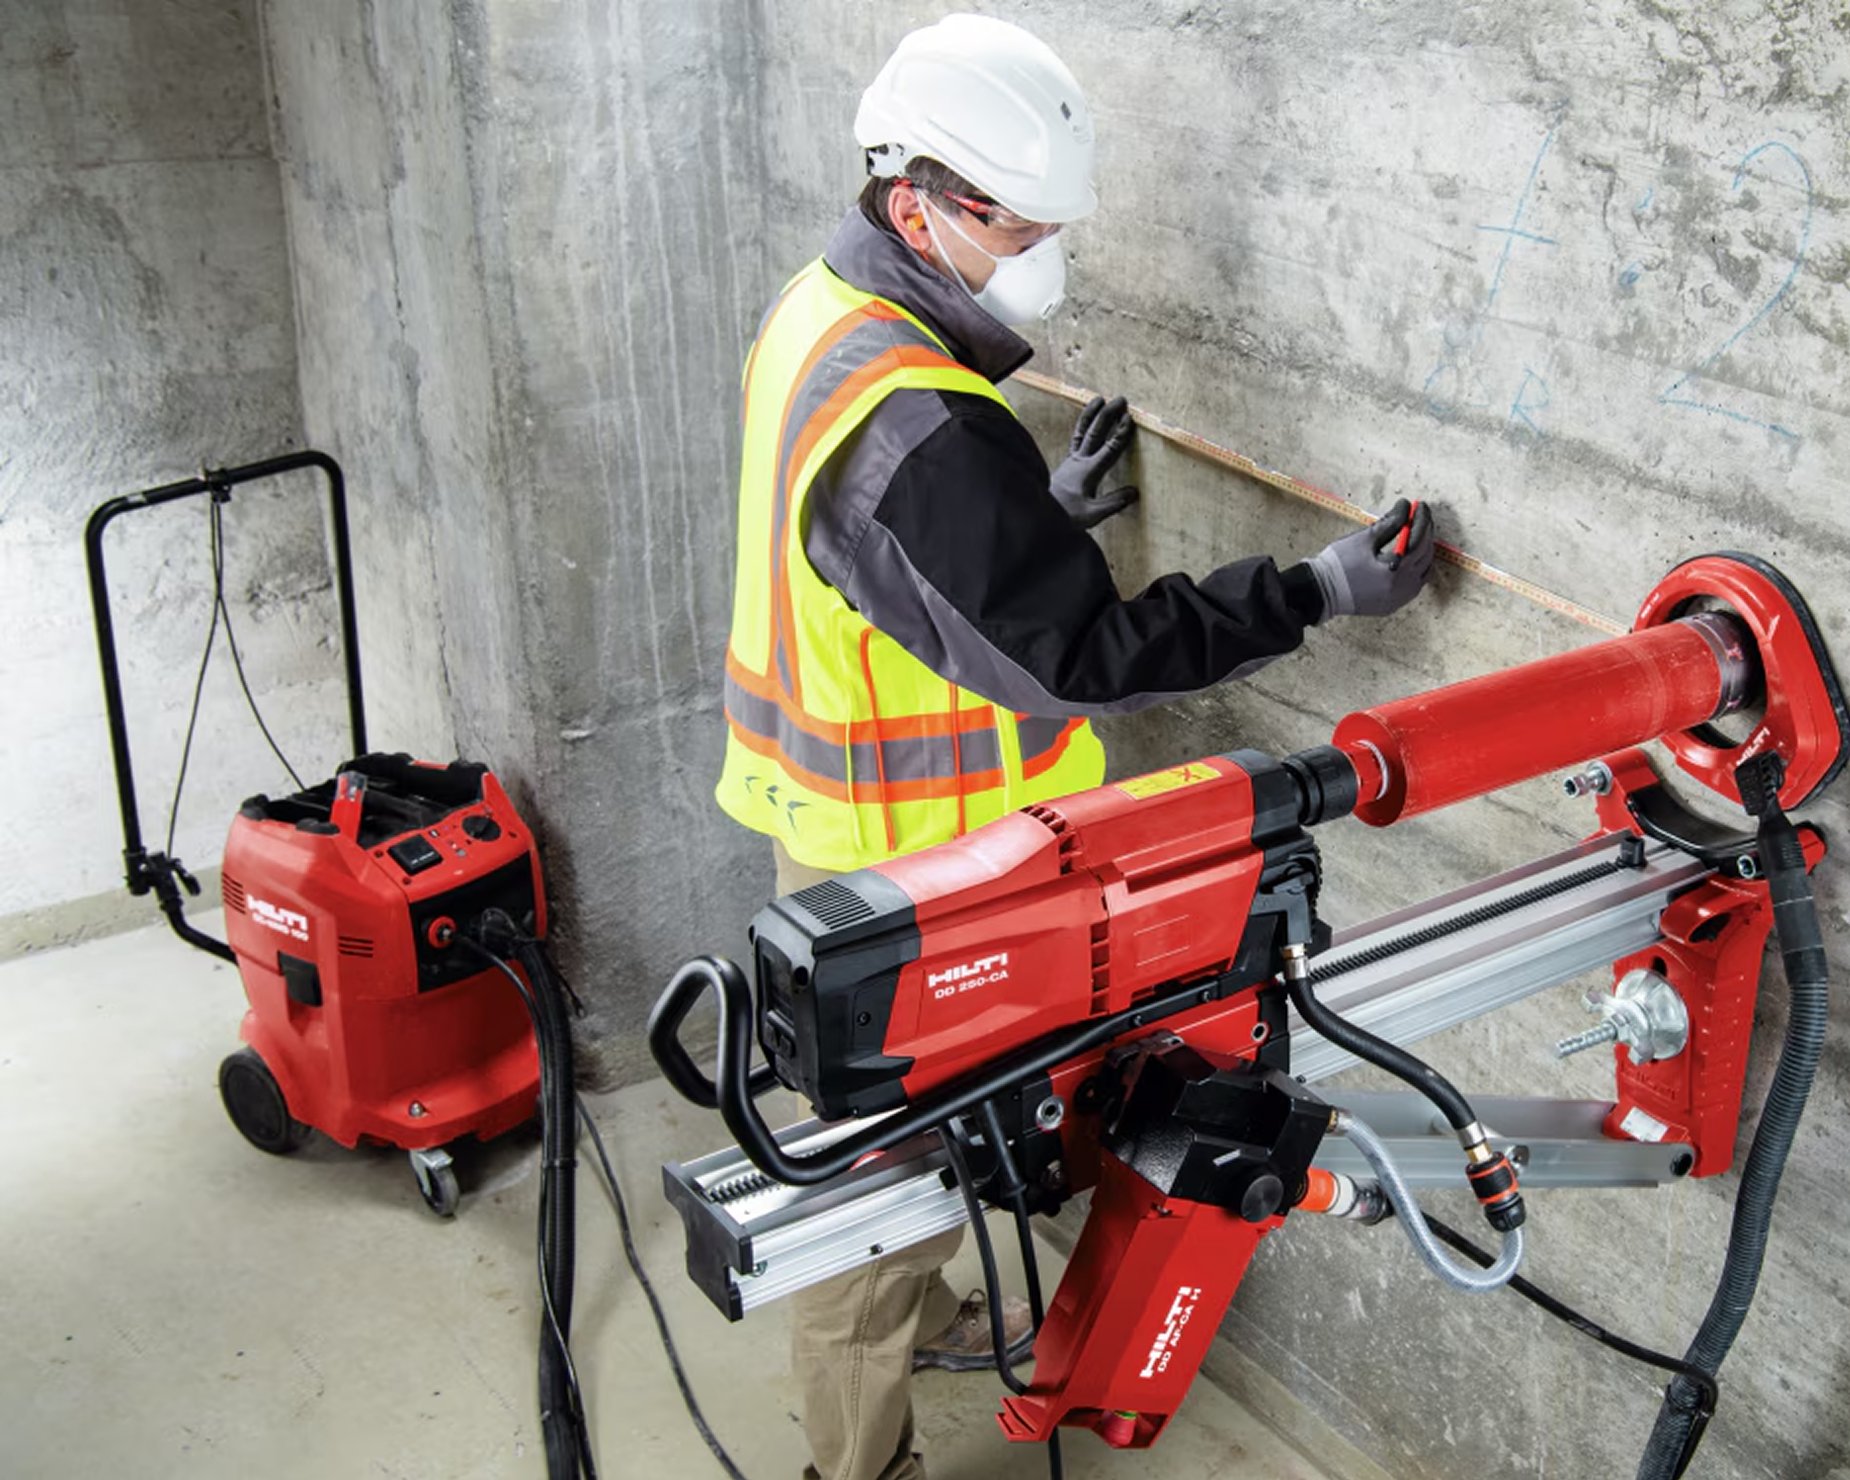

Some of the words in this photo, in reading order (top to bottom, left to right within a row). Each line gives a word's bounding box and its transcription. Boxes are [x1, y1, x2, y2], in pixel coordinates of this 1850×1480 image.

[246, 894, 308, 931] HILTI
[928, 952, 1008, 988] HILTI
[934, 986, 955, 1000] DD
[958, 970, 1009, 993] 250-CA
[1139, 1286, 1192, 1378] HILTI
[1157, 1351, 1172, 1372] DD
